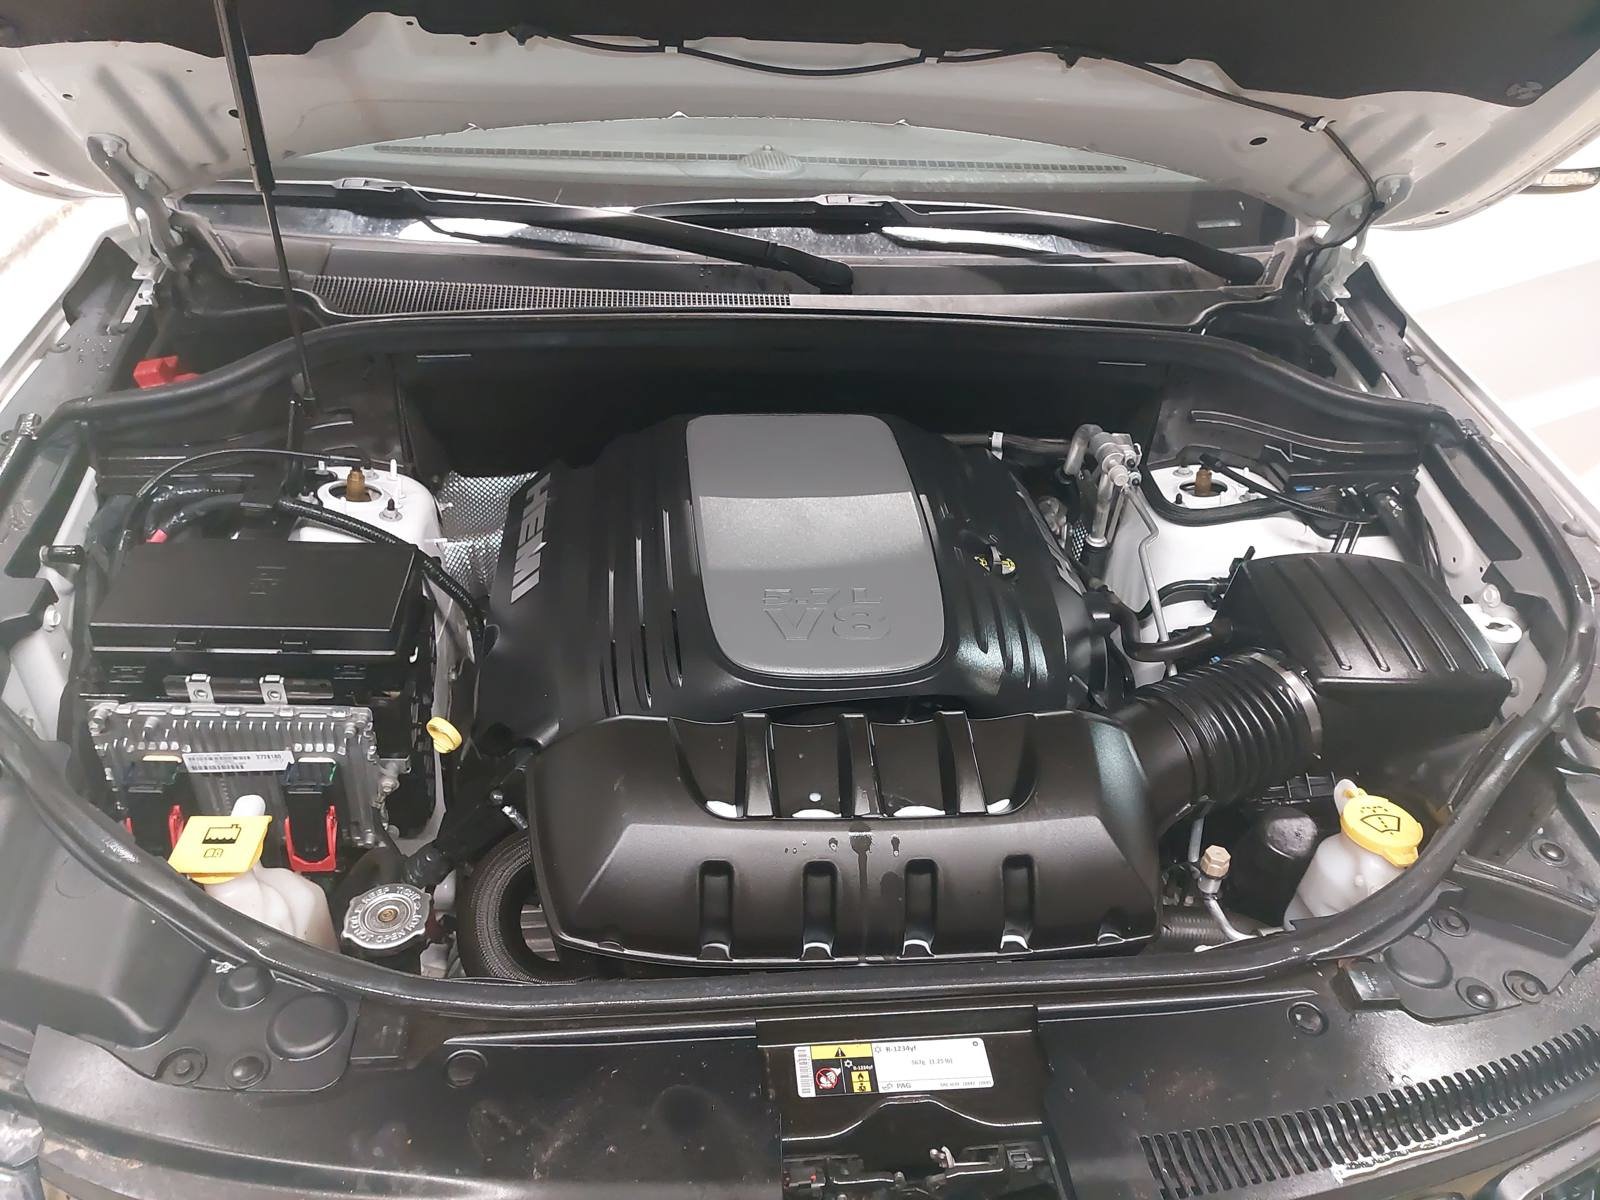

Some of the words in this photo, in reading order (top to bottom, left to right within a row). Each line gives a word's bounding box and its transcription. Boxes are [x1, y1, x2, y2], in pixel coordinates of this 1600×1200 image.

[510, 472, 551, 604] HEMI
[762, 587, 882, 606] 5.7L
[762, 607, 892, 641] V8
[362, 886, 390, 904] KEEP
[396, 886, 422, 902] TIGHT
[375, 929, 406, 943] OPEN
[885, 1045, 917, 1053] R-1234yf
